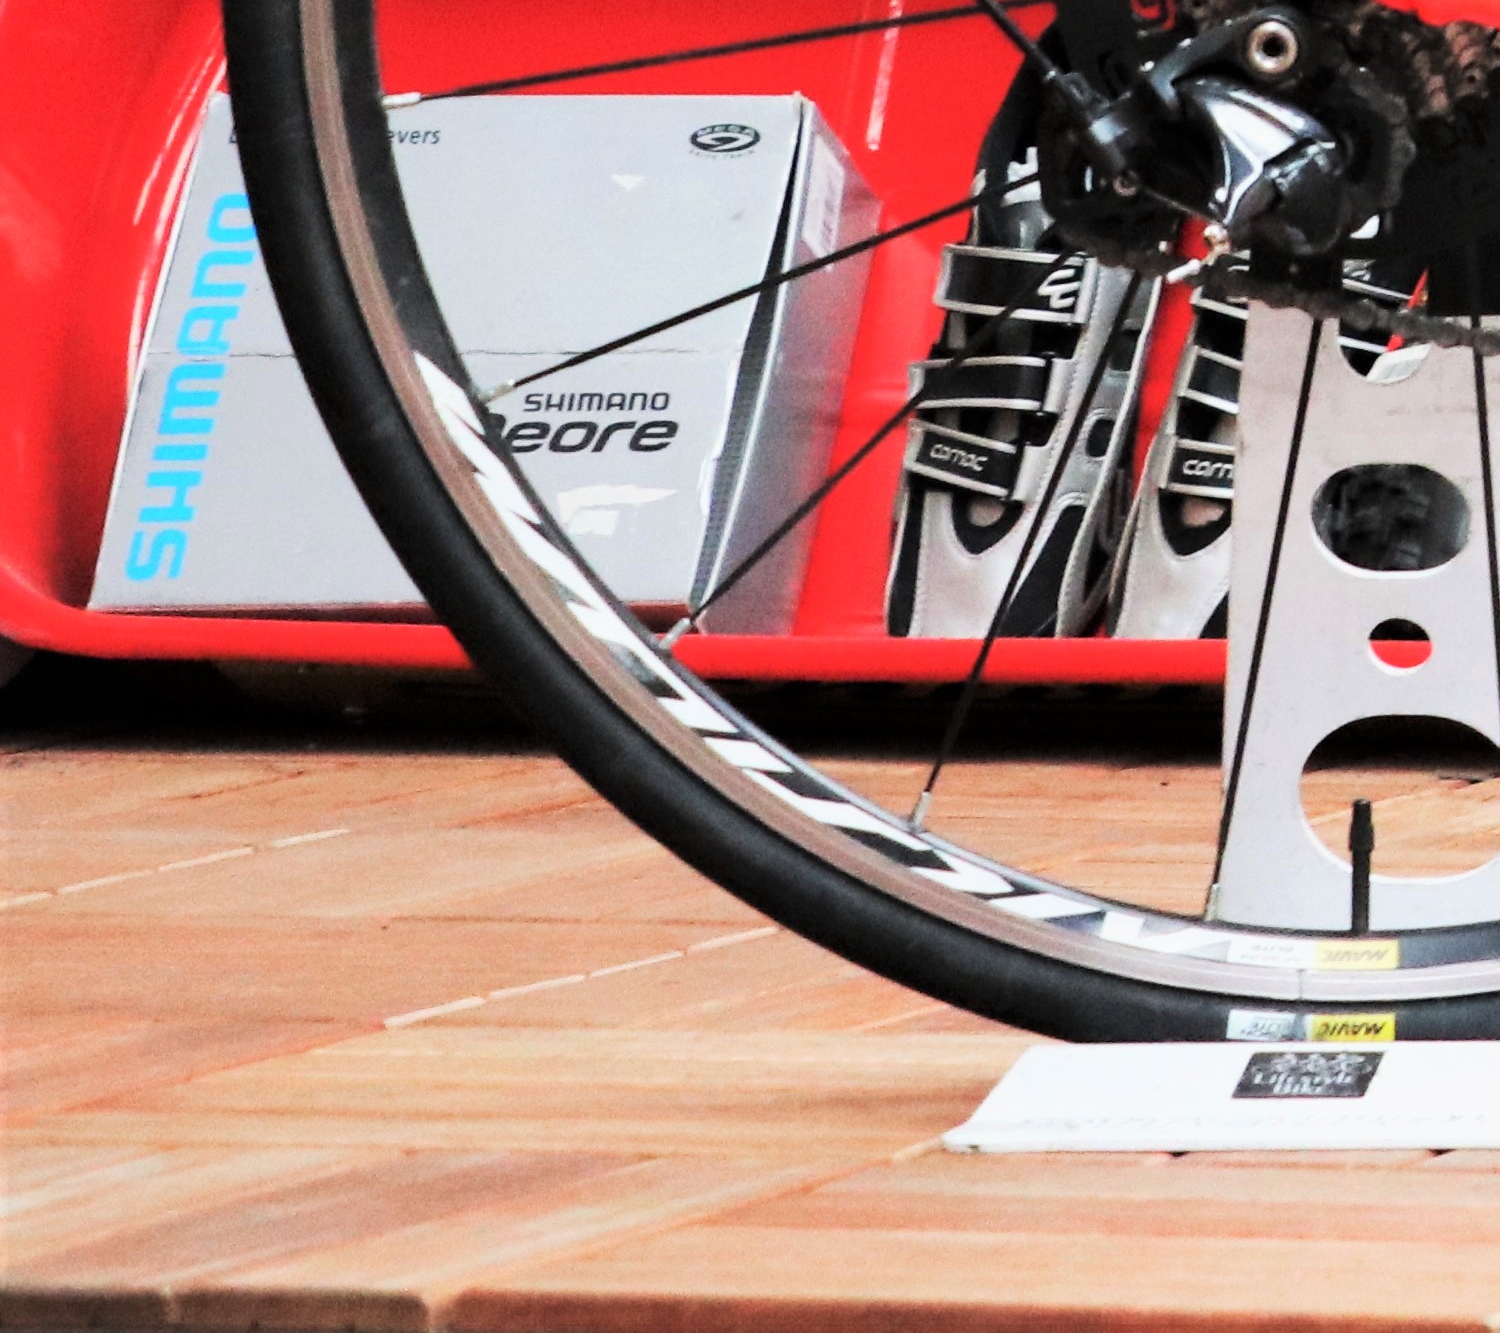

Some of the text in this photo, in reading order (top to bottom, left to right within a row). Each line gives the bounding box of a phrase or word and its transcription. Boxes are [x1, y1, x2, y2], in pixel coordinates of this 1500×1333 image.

[385, 125, 441, 146] evers
[126, 193, 257, 582] SHIMANO
[523, 391, 670, 414] SHIMANO
[1183, 457, 1235, 478] carn
[1322, 948, 1388, 961] MAVIC
[1320, 1021, 1388, 1037] MAVIC
